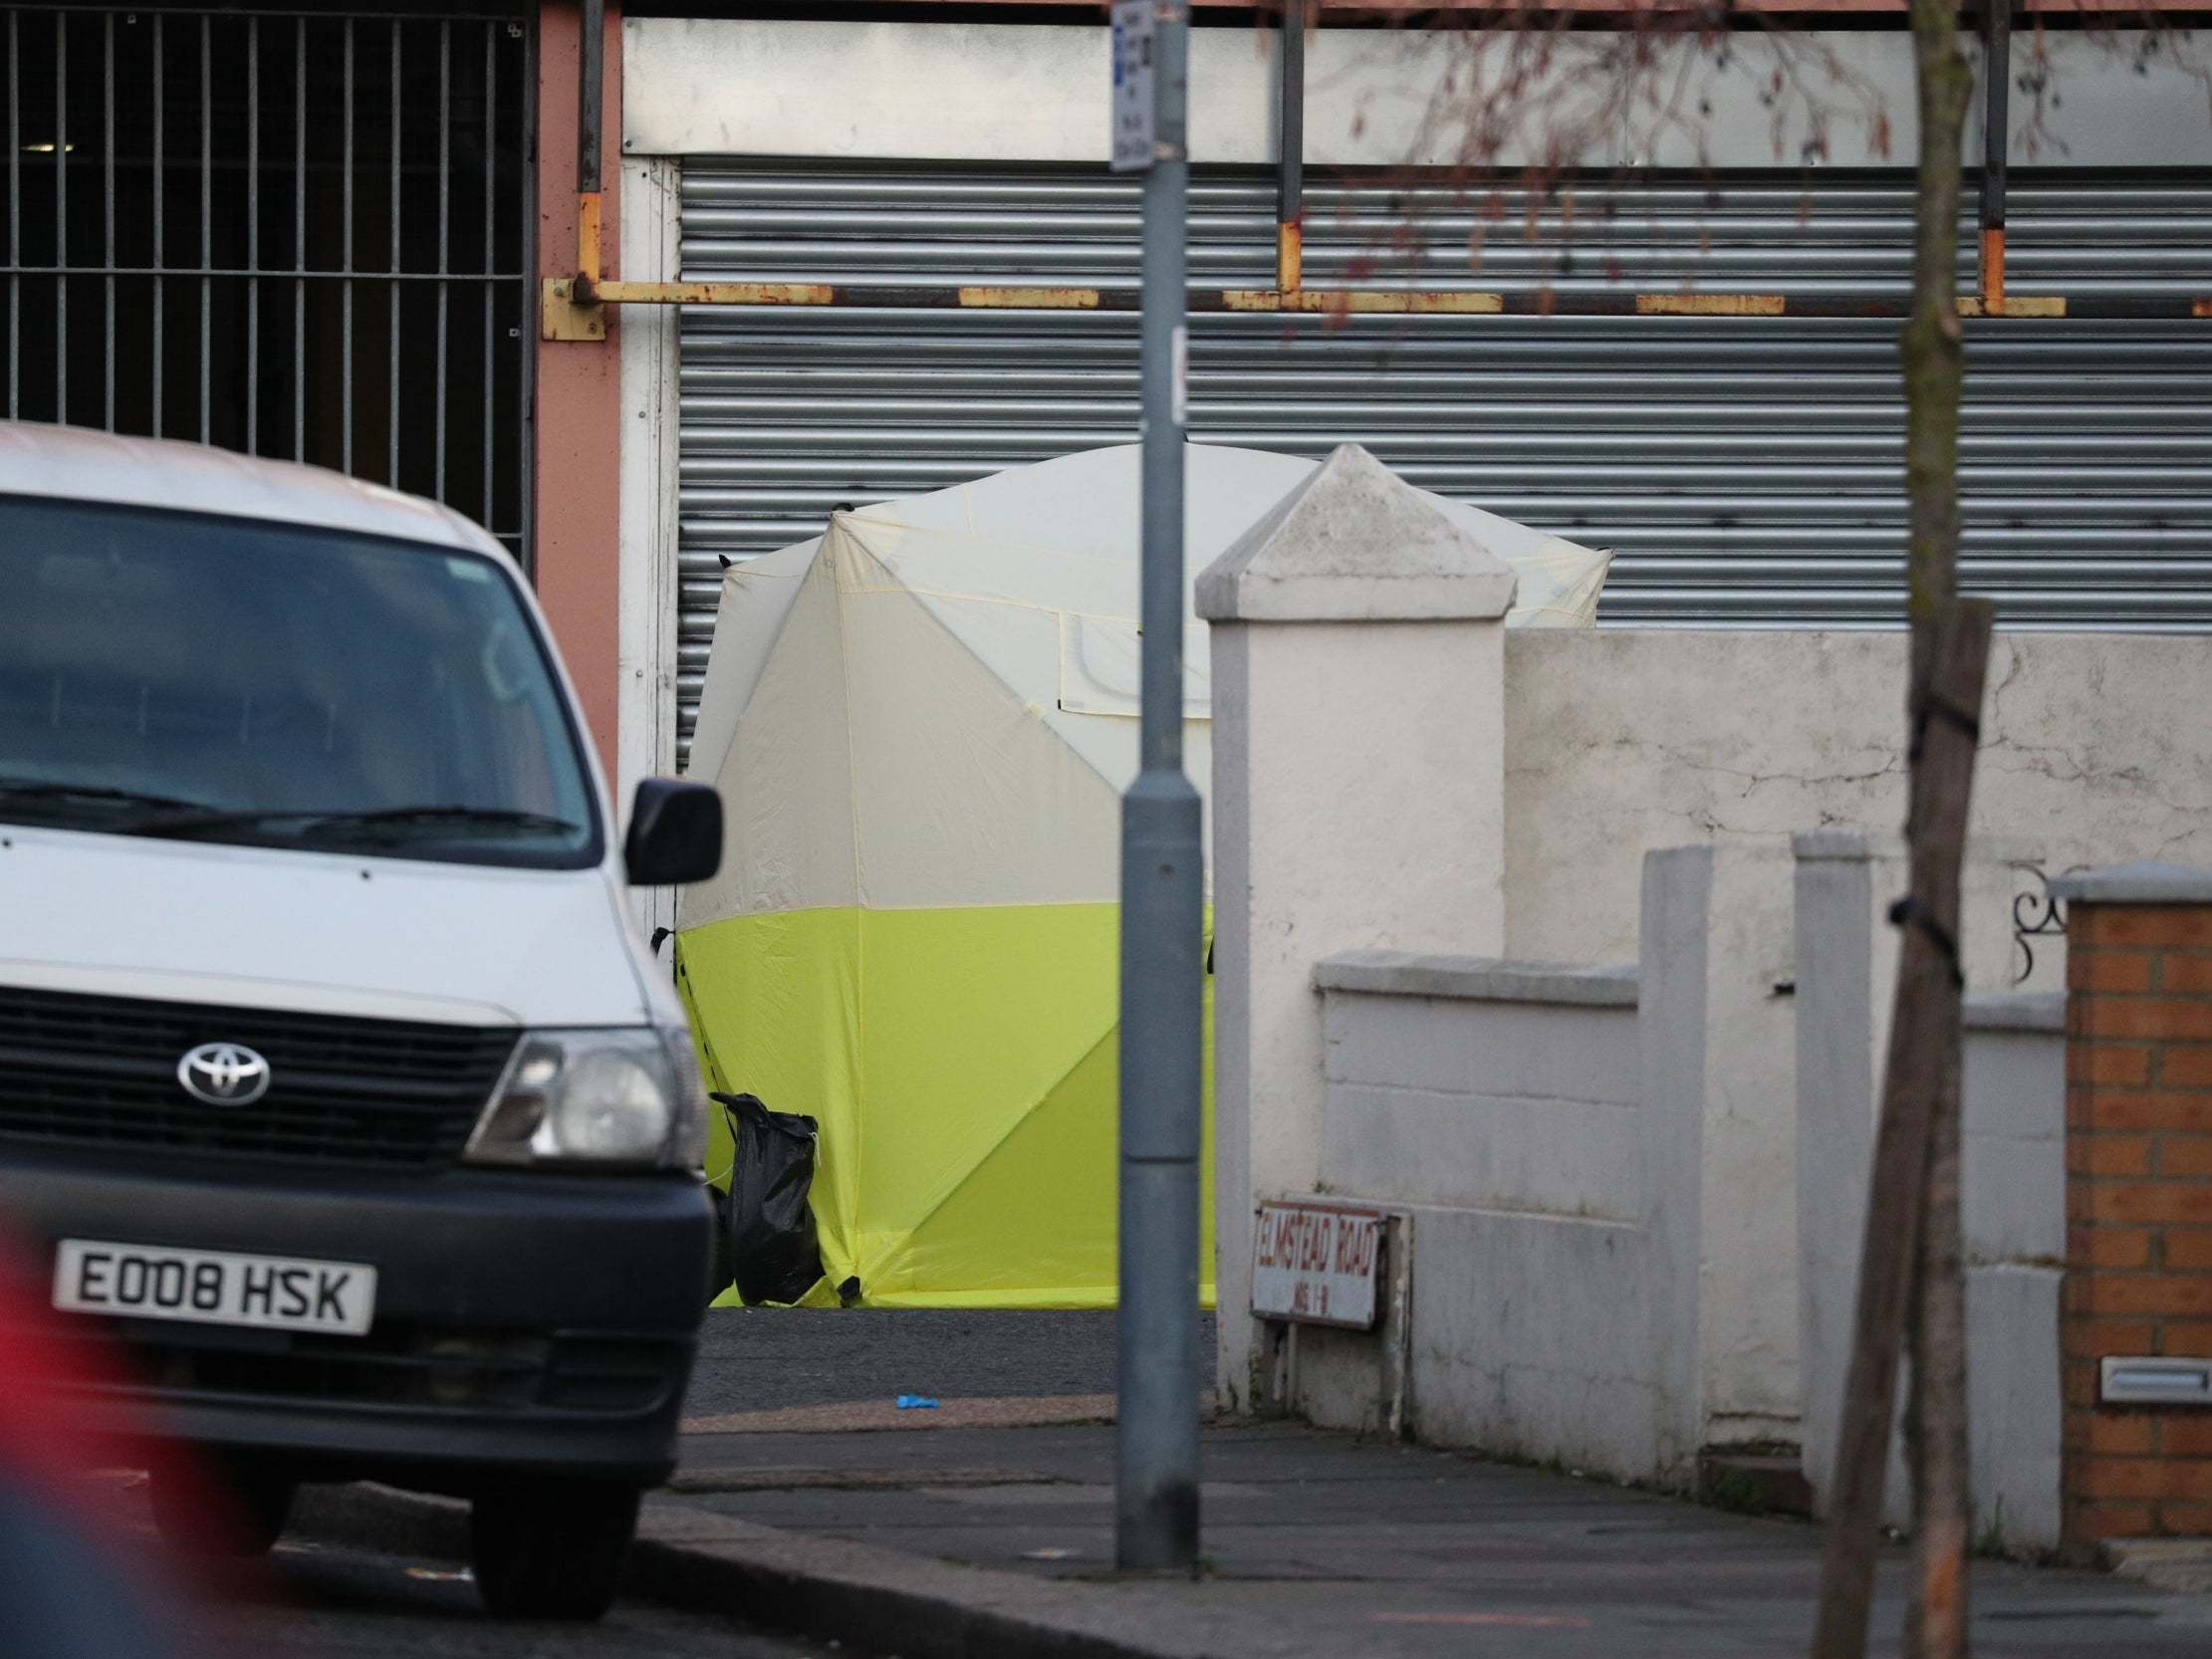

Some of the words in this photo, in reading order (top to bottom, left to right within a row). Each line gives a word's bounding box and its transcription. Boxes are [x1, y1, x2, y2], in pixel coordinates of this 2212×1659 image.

[1335, 1219, 1374, 1277] ROAD
[80, 1253, 222, 1310] EO08
[241, 1265, 351, 1321] HSK
